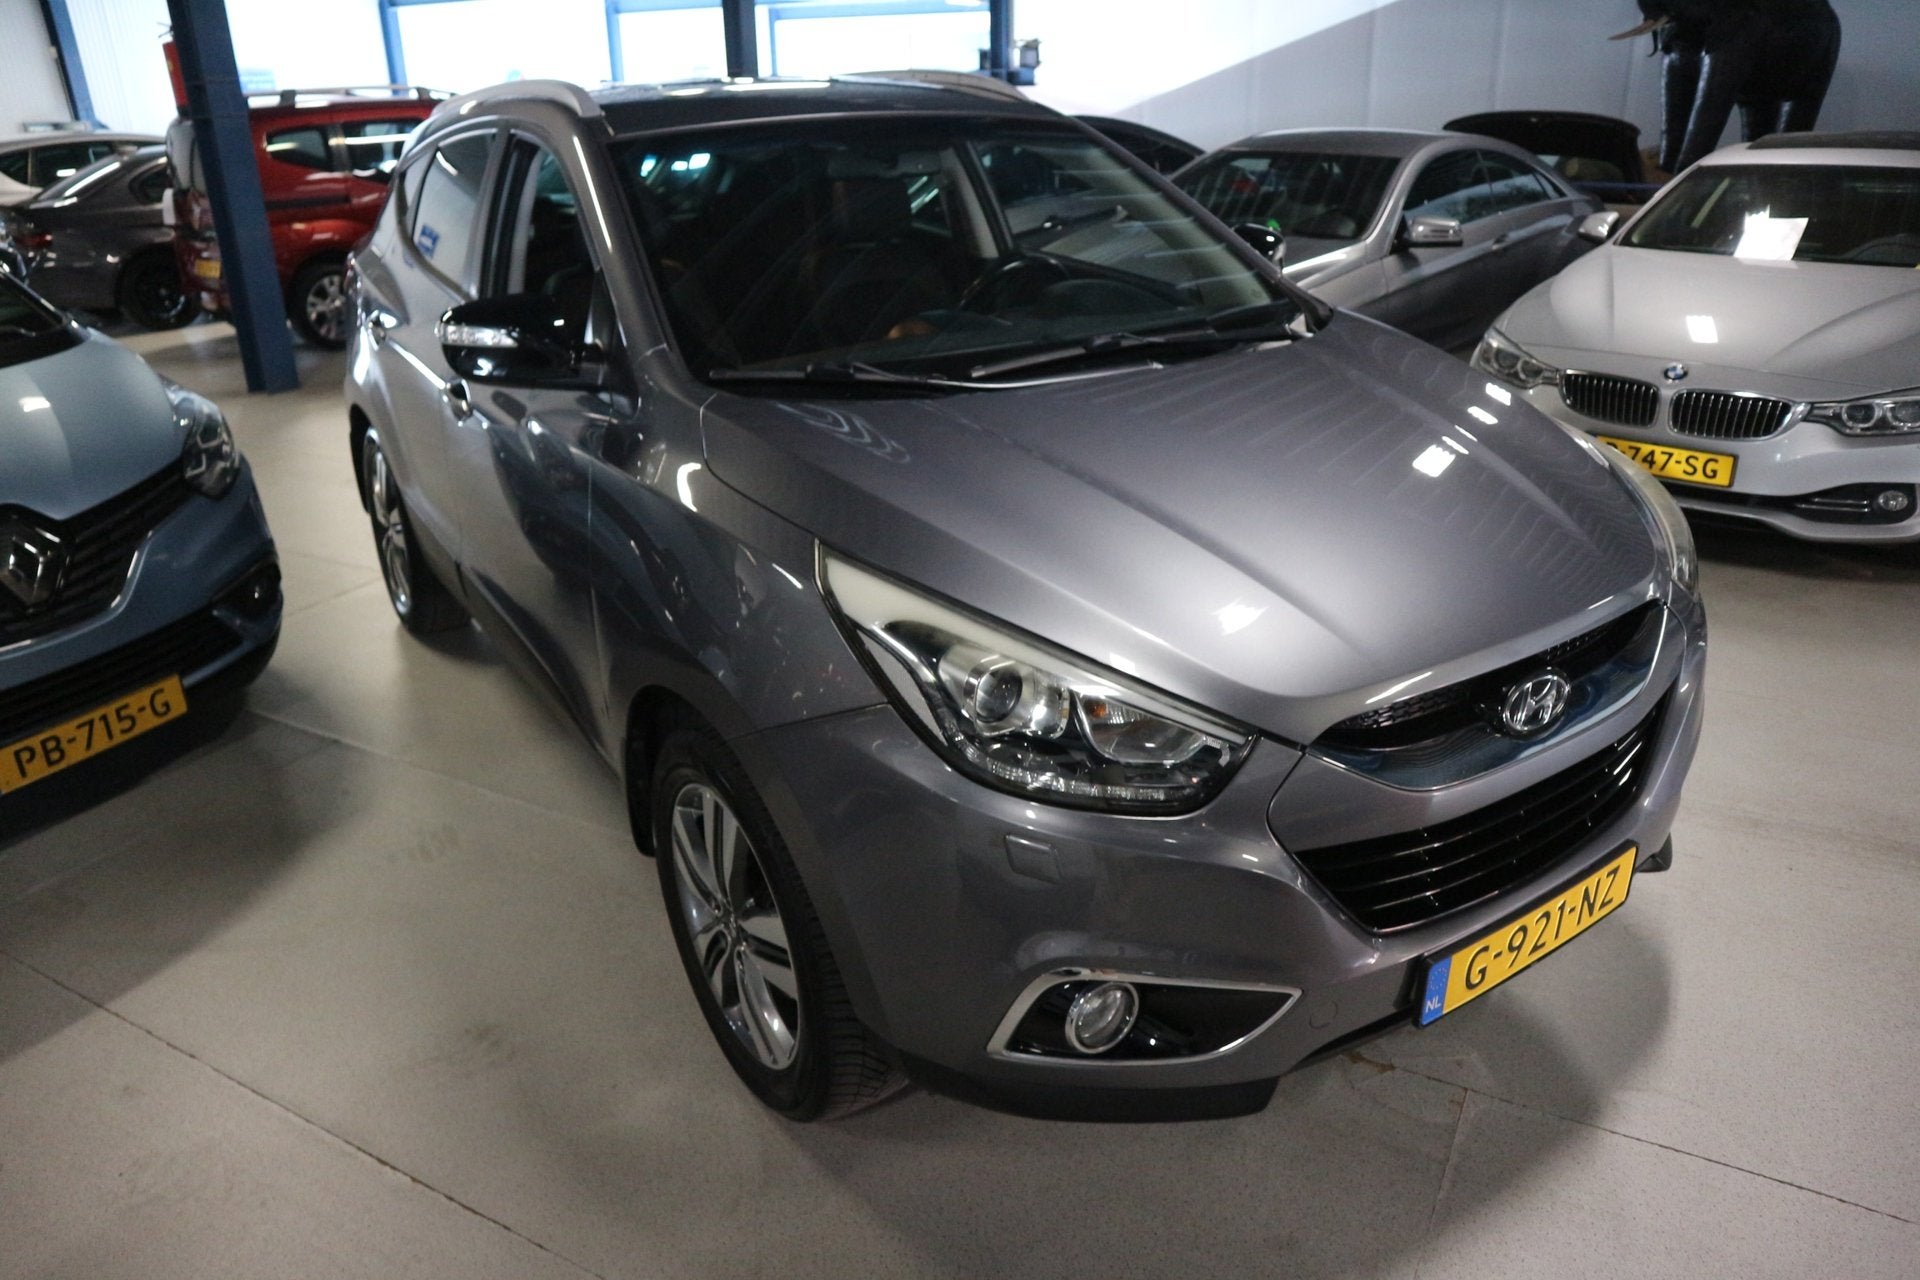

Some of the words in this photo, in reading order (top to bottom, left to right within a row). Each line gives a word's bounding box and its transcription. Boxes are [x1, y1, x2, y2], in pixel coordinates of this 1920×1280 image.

[1606, 441, 1719, 480] -747-SG
[13, 687, 171, 779] PB-715-G
[1464, 865, 1621, 991] G-921-NZ
[1424, 994, 1442, 1014] NL
